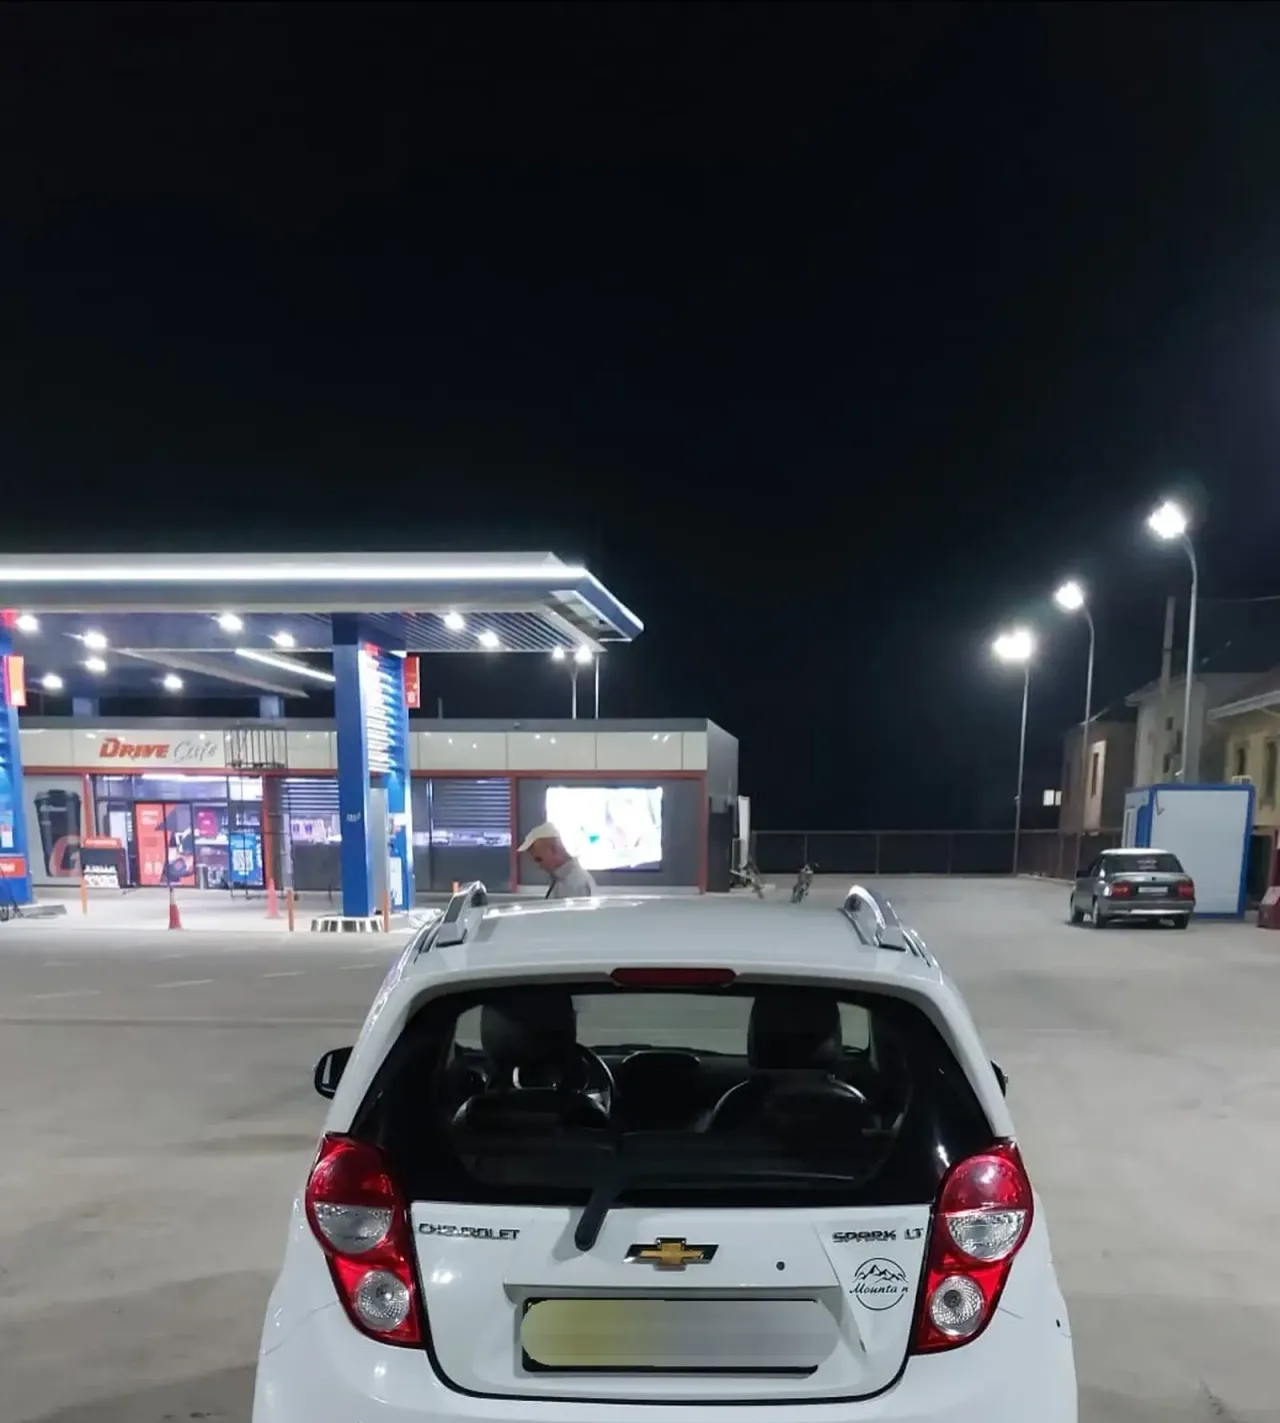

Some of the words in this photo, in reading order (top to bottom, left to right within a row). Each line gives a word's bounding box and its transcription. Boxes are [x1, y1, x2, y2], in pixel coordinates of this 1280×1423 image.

[99, 738, 170, 759] DRIVE
[418, 1222, 521, 1241] CHEROLET
[904, 1227, 925, 1241] LT
[848, 1282, 909, 1294] Mountan
